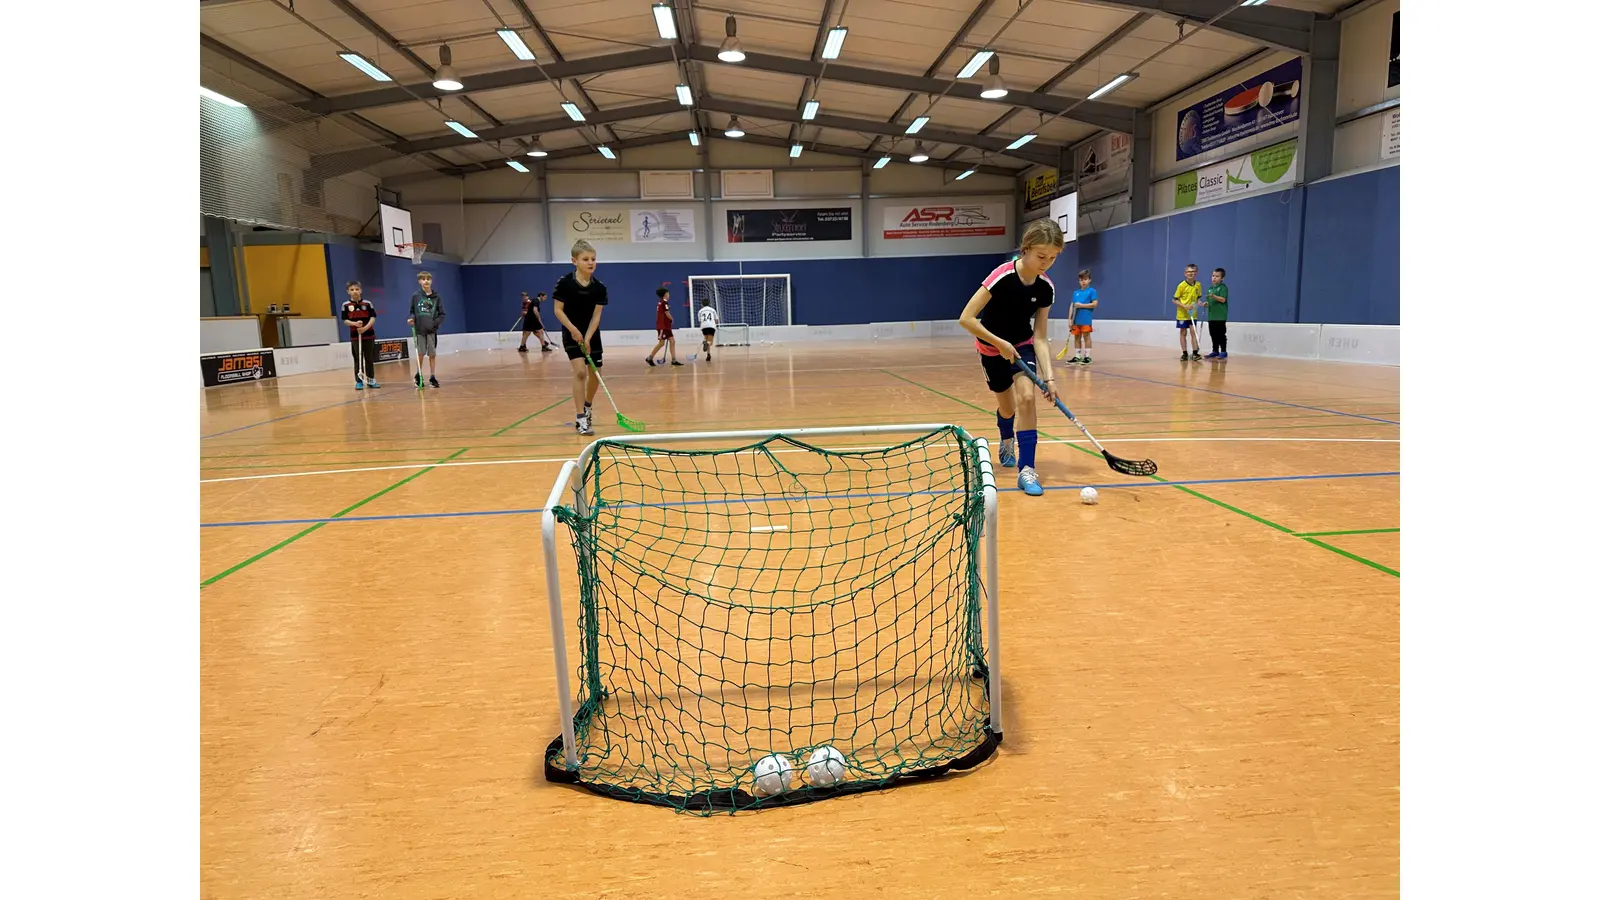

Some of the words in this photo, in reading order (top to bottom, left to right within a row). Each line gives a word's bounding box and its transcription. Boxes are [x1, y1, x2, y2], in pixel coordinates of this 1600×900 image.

[1199, 173, 1223, 188] Classic
[901, 206, 955, 222] ASR
[702, 313, 712, 321] 14
